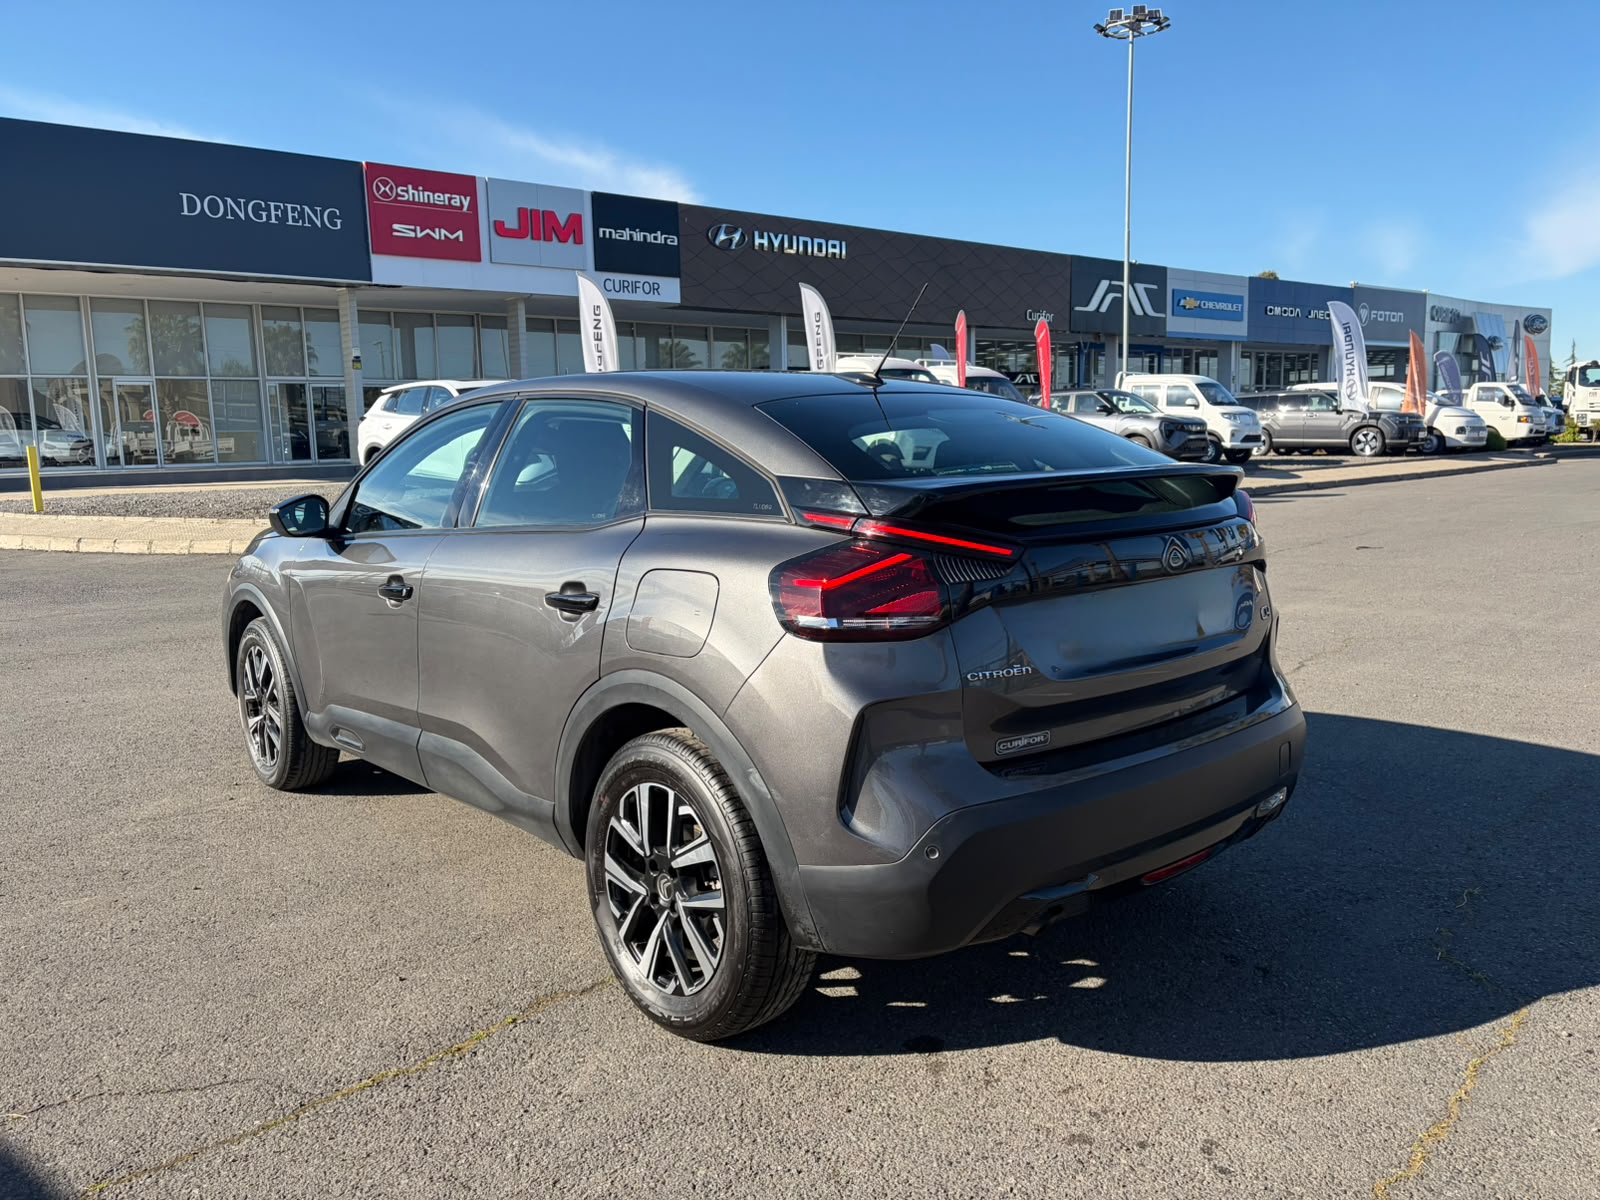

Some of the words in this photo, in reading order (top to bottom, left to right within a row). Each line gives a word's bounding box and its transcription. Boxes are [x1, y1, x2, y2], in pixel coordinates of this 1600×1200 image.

[179, 192, 343, 230] DONGFENG
[392, 223, 464, 242] SWM
[494, 207, 584, 245] JIM
[598, 226, 679, 246] mahindra
[753, 230, 847, 260] HYUNDAI
[603, 278, 661, 296] CURIFOR
[1073, 279, 1167, 318] JAC
[1200, 302, 1244, 313] CHEVROLET
[1266, 305, 1302, 318] OMODA
[1308, 309, 1331, 321] JAEC
[1371, 310, 1405, 323] FOTON
[592, 304, 603, 372] GFENG
[966, 664, 1033, 682] CITROËN
[999, 733, 1046, 751] CURIFOR
